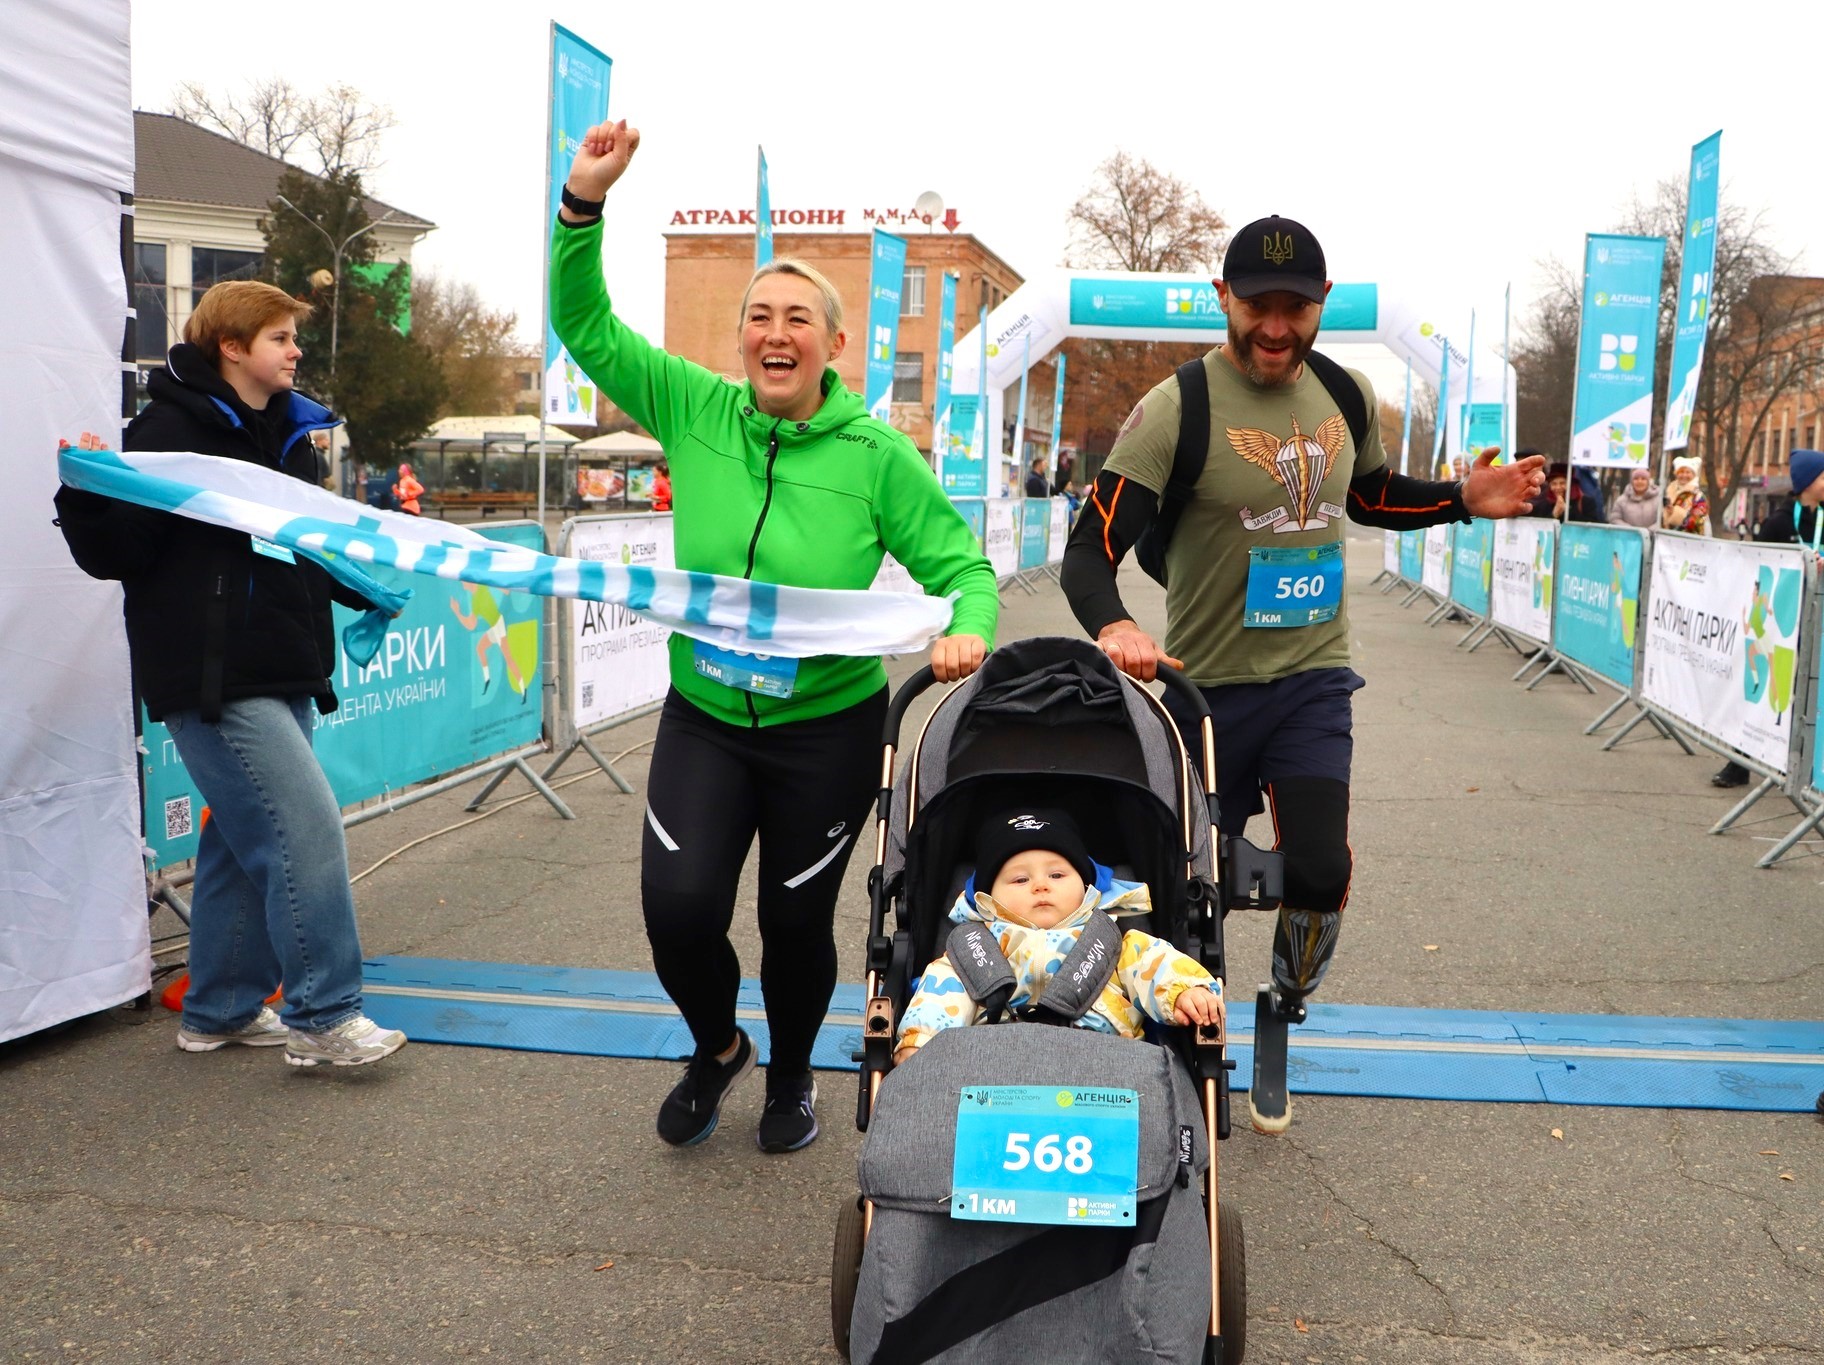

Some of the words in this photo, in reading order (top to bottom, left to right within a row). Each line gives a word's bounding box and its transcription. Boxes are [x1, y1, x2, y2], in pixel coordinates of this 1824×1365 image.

[1610, 294, 1652, 304] АГЕНЦІЯ
[997, 313, 1031, 345] АГЕНЦІЯ
[836, 432, 870, 444] CRAFT
[1252, 508, 1282, 528] ЗАВЖДИ
[1275, 574, 1325, 599] 560
[581, 600, 643, 637] АКТИВ
[1693, 611, 1738, 656] ПАРКИ
[312, 692, 383, 730] ЗИДЕНТА
[384, 676, 446, 711] УКРАЇНИ
[1075, 1092, 1126, 1104] АГЕНЦІЯ
[1003, 1132, 1093, 1175] 568
[968, 1193, 978, 1213] 1
[1088, 1201, 1117, 1209] АКТИВНІ
